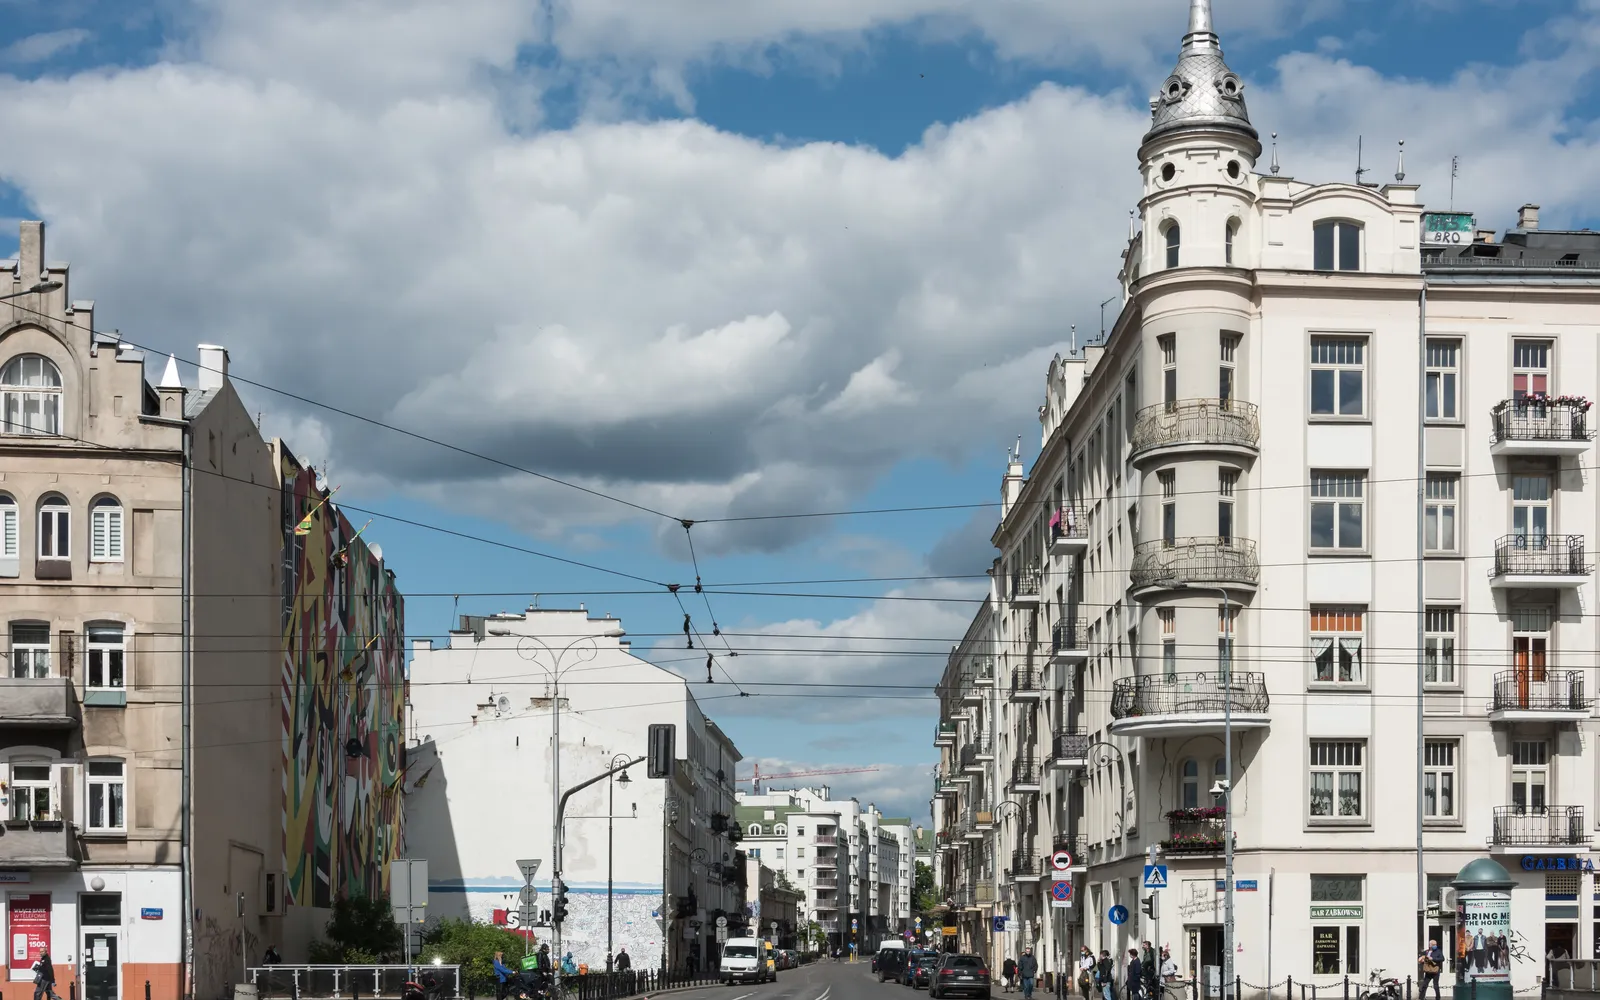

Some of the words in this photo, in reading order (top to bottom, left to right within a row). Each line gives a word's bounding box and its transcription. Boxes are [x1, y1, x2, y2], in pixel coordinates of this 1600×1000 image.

[1435, 231, 1460, 243] BRO
[1521, 855, 1595, 871] GALERIA
[1325, 908, 1361, 916] ZĄBKOWSKI
[1465, 912, 1498, 920] BRING
[1500, 912, 1510, 920] ME
